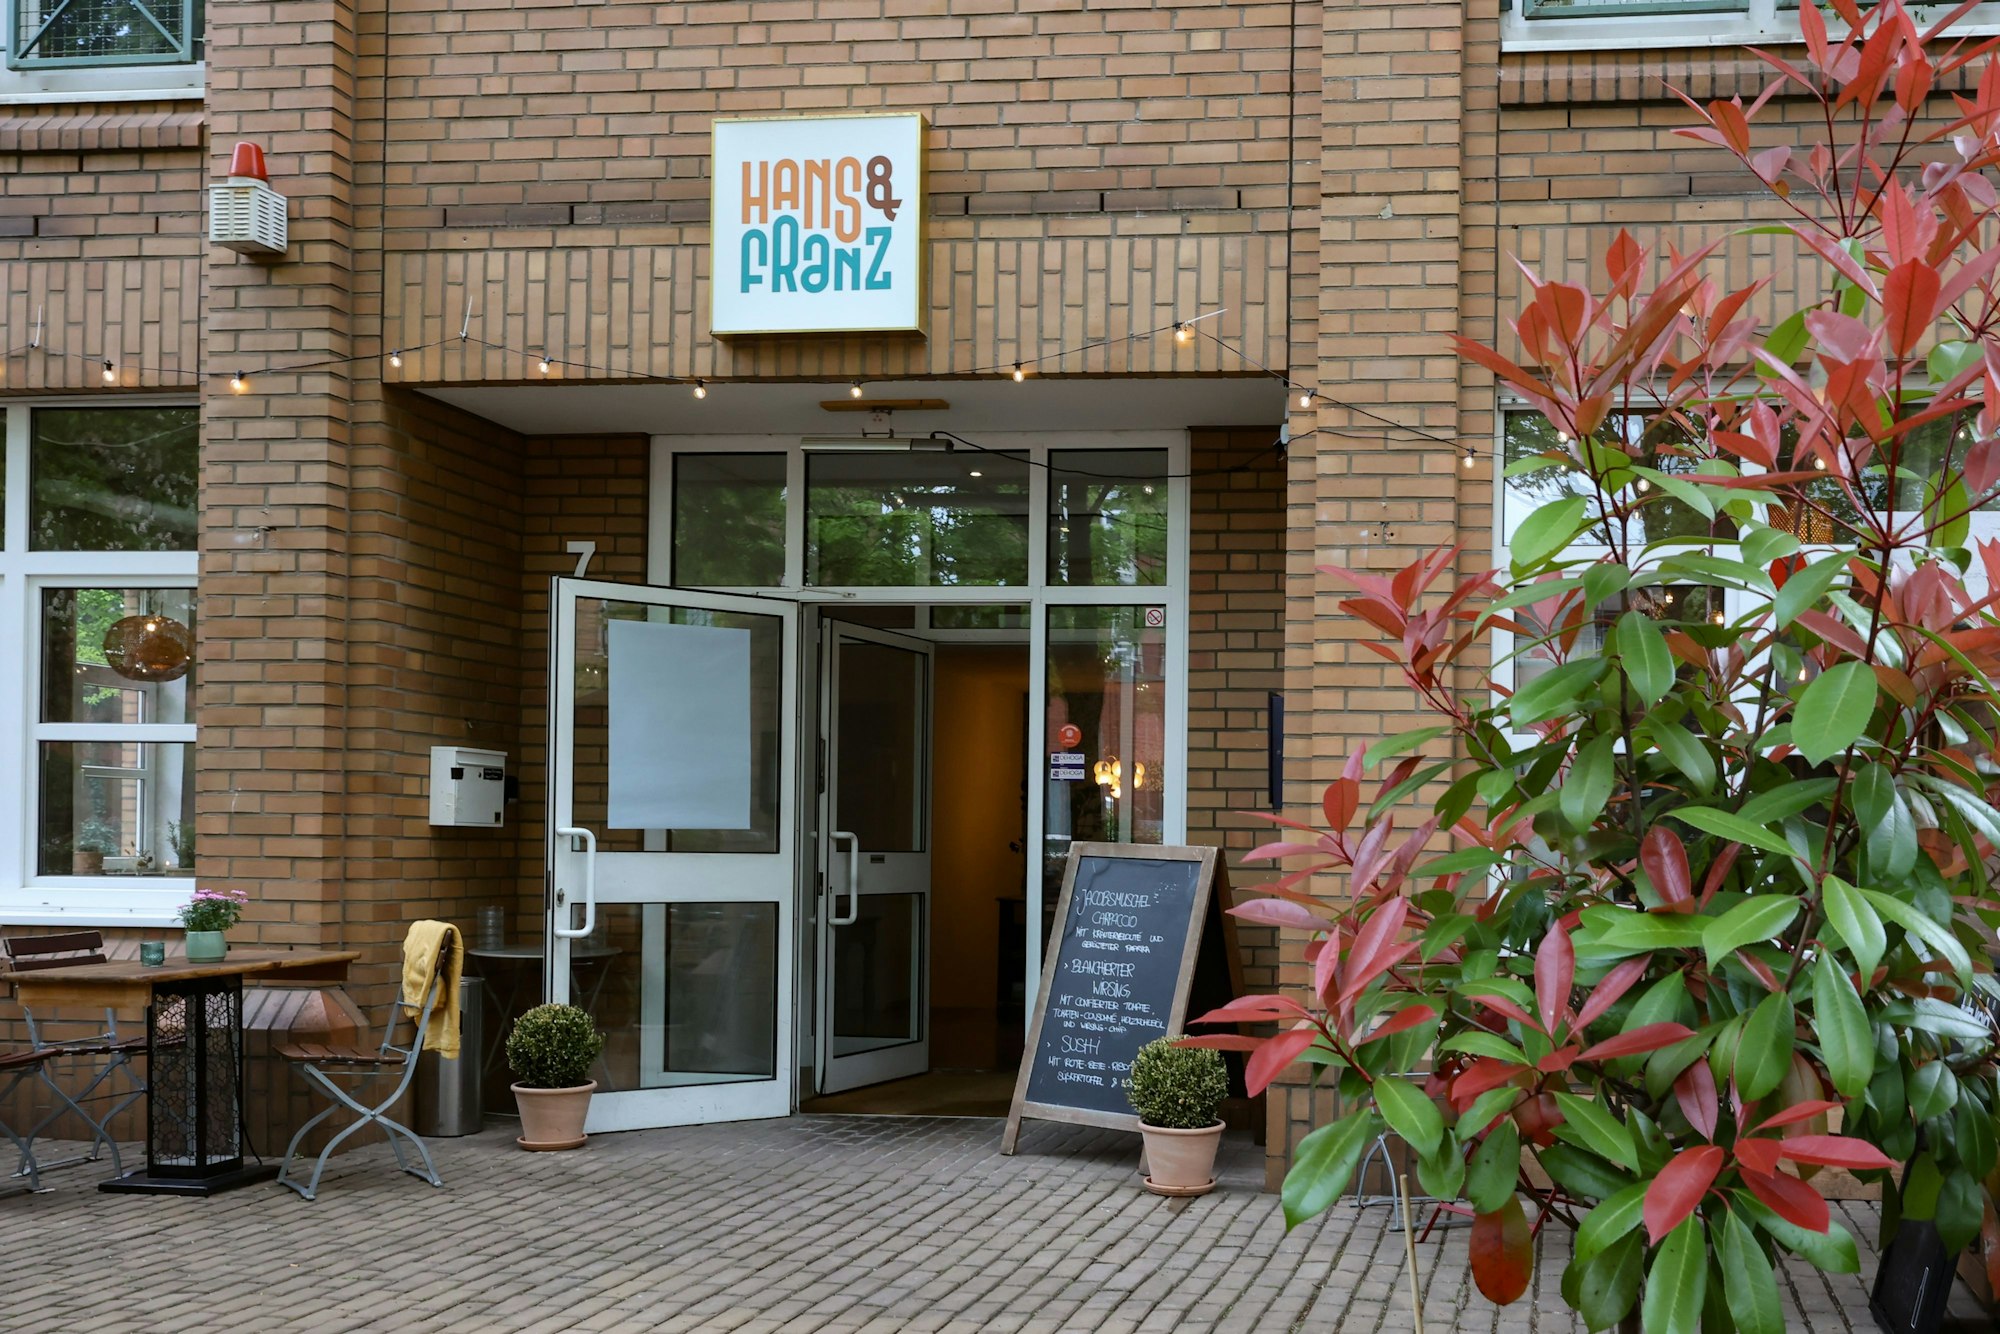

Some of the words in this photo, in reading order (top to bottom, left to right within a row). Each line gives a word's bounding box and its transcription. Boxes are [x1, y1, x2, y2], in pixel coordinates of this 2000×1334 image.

[741, 156, 862, 243] HANS
[866, 155, 903, 222] &
[566, 541, 596, 578] 7
[1076, 889, 1151, 916] JACOBSMUSCHEL
[1091, 911, 1138, 928] CARPACCIO
[1075, 926, 1089, 938] MIT
[1149, 935, 1164, 943] UND
[1070, 958, 1136, 978] BLANCHIERTER
[1060, 993, 1074, 1006] MIT
[1063, 1020, 1076, 1028] UND
[1061, 1035, 1101, 1055] SUSHI
[1048, 1056, 1061, 1067] MIT
